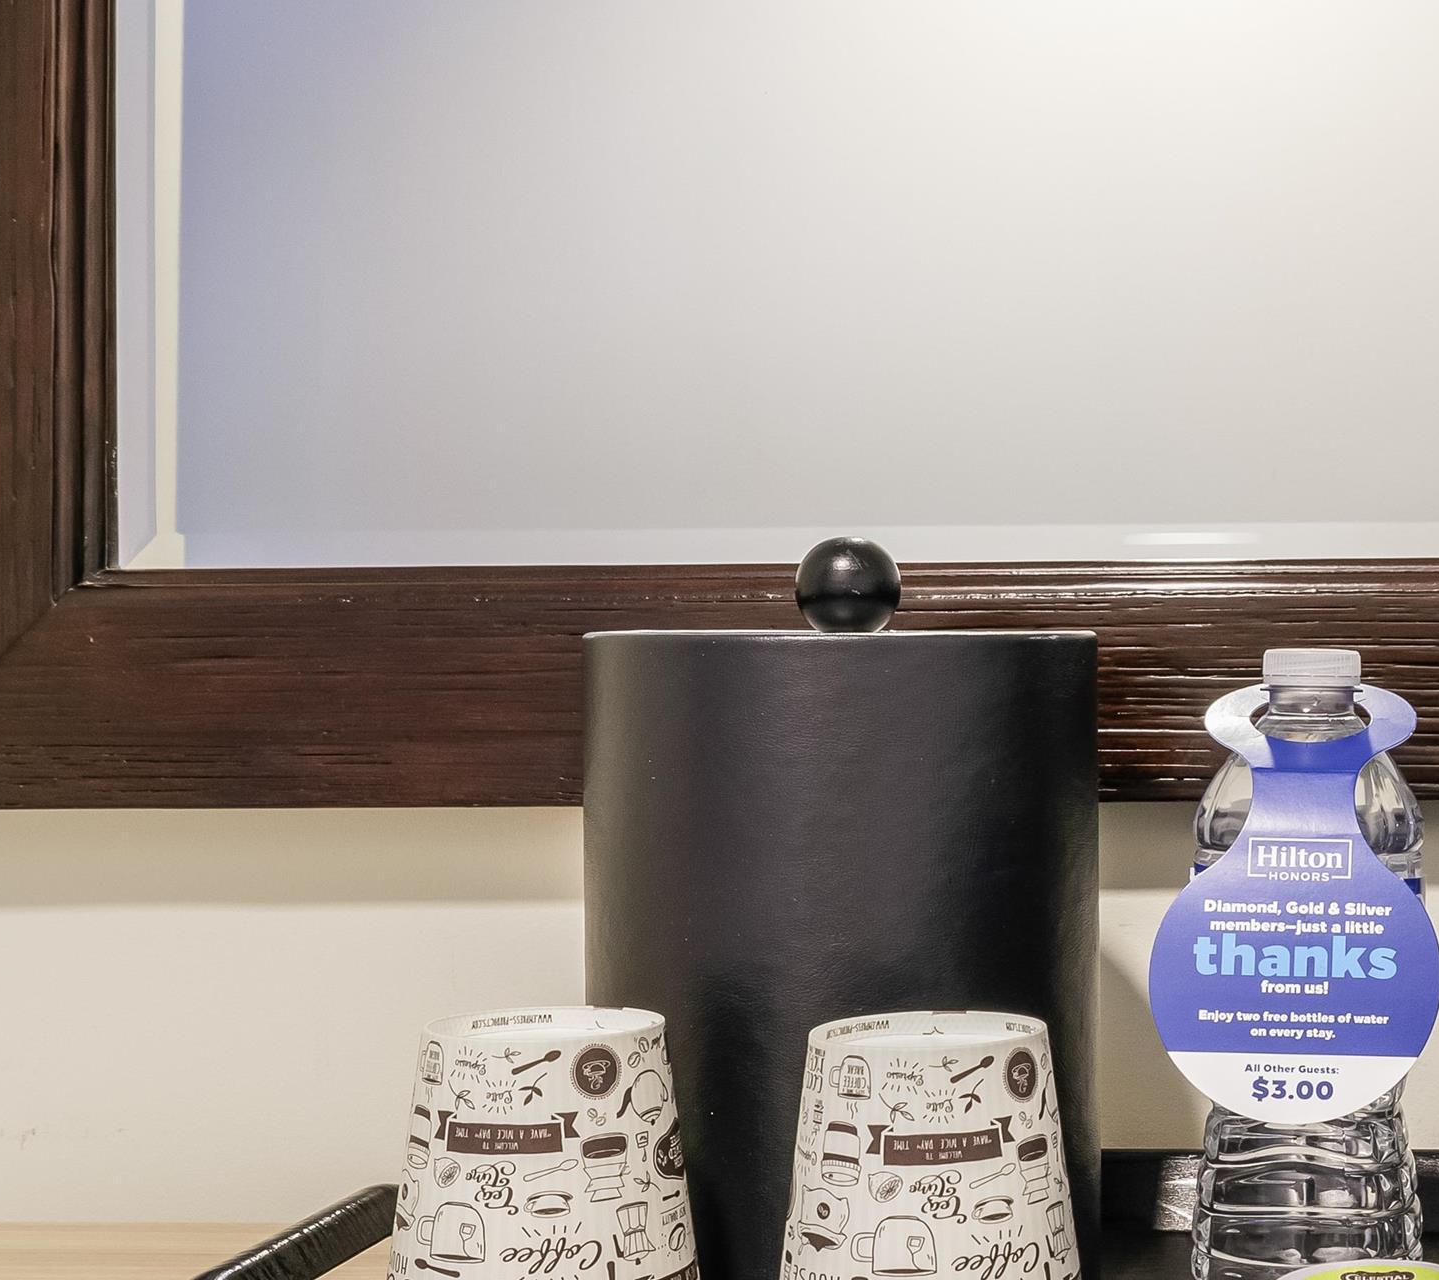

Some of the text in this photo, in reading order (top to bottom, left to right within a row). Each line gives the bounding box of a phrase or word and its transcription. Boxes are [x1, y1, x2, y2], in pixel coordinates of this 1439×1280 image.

[1256, 845, 1343, 869] Hilton
[1268, 872, 1330, 882] HONORS
[1203, 899, 1393, 917] Diamond, Gold & Silver
[1330, 923, 1341, 933] a
[1344, 920, 1384, 935] little
[1193, 933, 1397, 980] thanks
[1260, 980, 1329, 995] from us!
[1198, 1009, 1390, 1025] Enjoy two free bottles of water
[1249, 1027, 1336, 1041] on every stay.
[1244, 1063, 1339, 1075] All Other Guests:
[886, 1071, 924, 1086] Espresso
[1251, 1076, 1334, 1102] $3.00
[455, 1126, 469, 1138] TIME
[497, 1129, 514, 1139] NICE
[519, 1129, 524, 1139] A
[893, 1139, 910, 1150] TIME
[940, 1137, 958, 1148] NICE
[962, 1137, 968, 1147] A
[465, 1160, 517, 1188] Time
[909, 1170, 963, 1199] Time
[474, 1186, 519, 1216] Tea
[920, 1196, 967, 1224] Tea
[499, 1236, 602, 1275] Coffee
[951, 1241, 1040, 1280] Coffee
